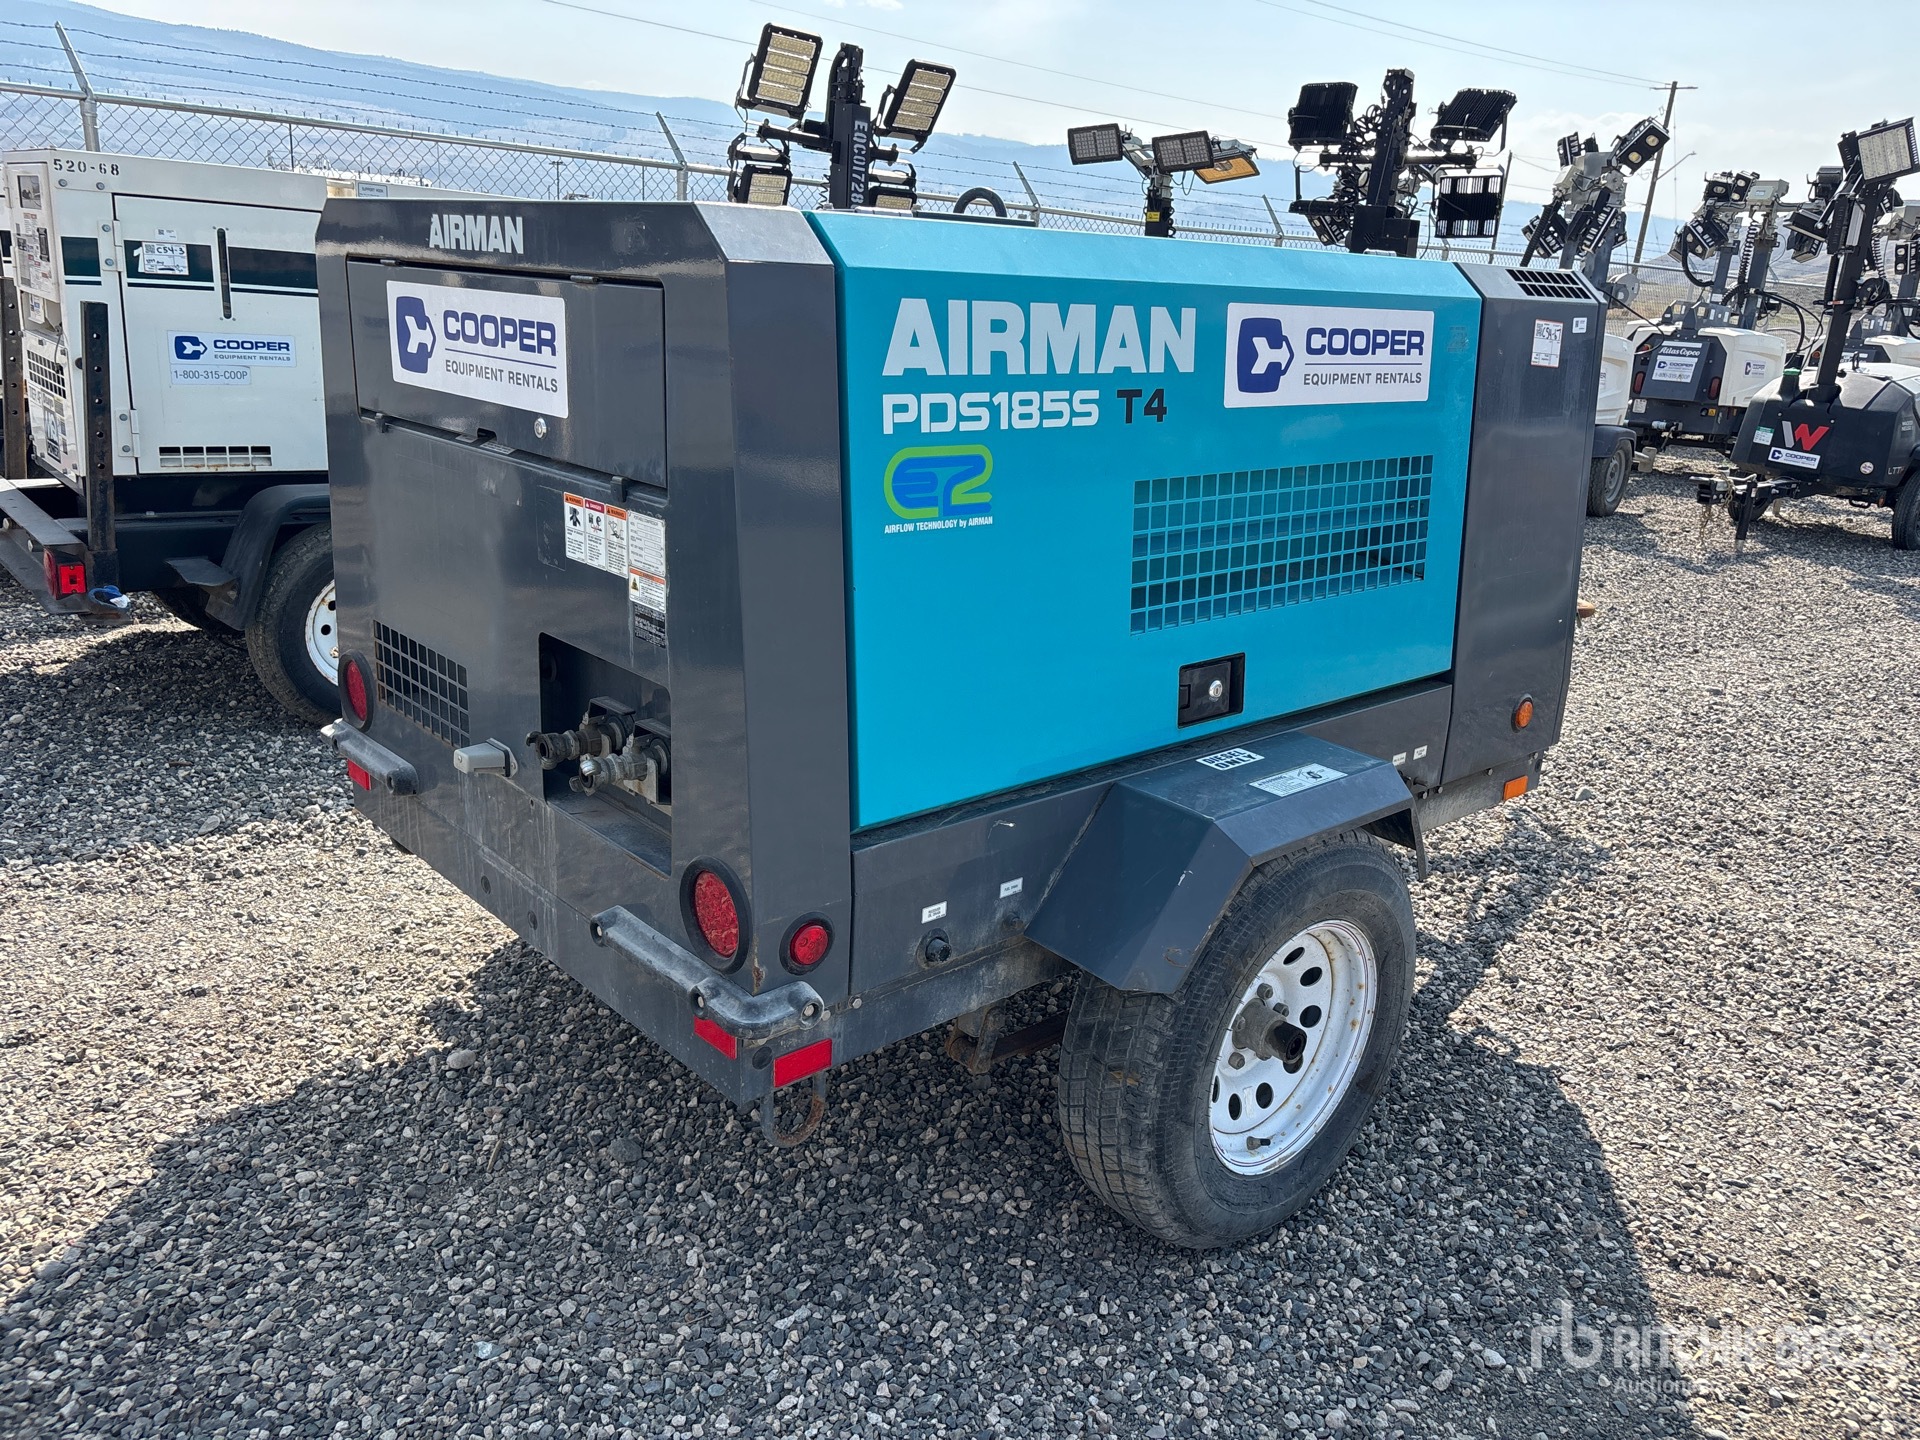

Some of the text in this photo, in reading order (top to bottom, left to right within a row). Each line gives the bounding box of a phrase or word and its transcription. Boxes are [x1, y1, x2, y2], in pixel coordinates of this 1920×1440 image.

[53, 158, 121, 176] 520-68
[429, 213, 524, 254] AIRMAN
[444, 309, 557, 357] COOPER
[882, 298, 1196, 376] AIRMAN
[213, 338, 291, 353] COOPER
[1305, 327, 1425, 356] COOPER
[214, 353, 257, 361] EQUIPMENT
[1659, 347, 1701, 357] Atlas Copco
[173, 368, 248, 381] 1-800-315-COOP
[445, 359, 558, 393] EQUIPMENT RENTALS
[1303, 372, 1422, 386] EQUIPMENT RENTALS
[882, 388, 1168, 435] PDS185S T4
[1785, 452, 1817, 462] COOPER
[884, 516, 993, 534] AIRFLOW TECHNOLOGY by AIRMAN
[1202, 750, 1247, 764] DIESEL
[1214, 754, 1257, 768] ONLY
